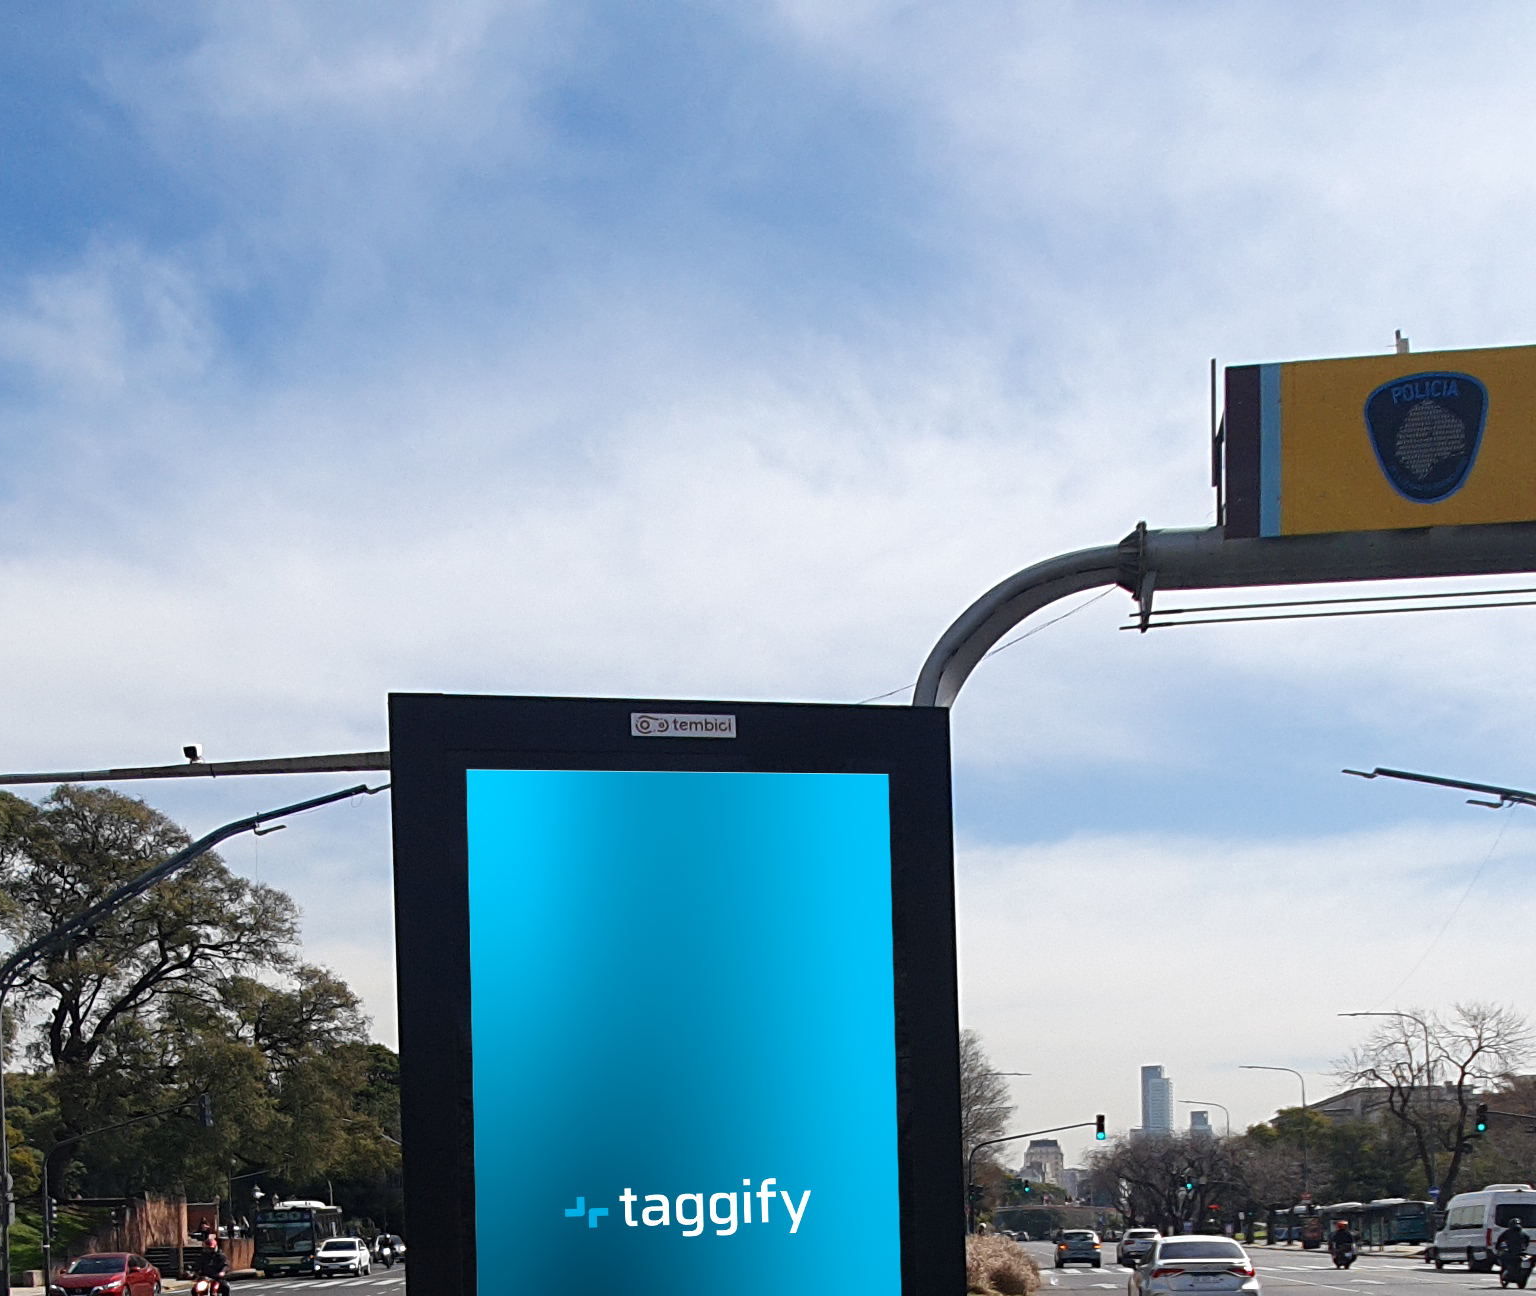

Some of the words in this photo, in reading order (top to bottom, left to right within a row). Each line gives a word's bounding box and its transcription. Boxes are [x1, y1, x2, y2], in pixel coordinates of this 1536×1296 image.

[1391, 380, 1459, 405] POLICIA
[672, 717, 732, 732] tembici
[619, 1177, 811, 1237] taggify
